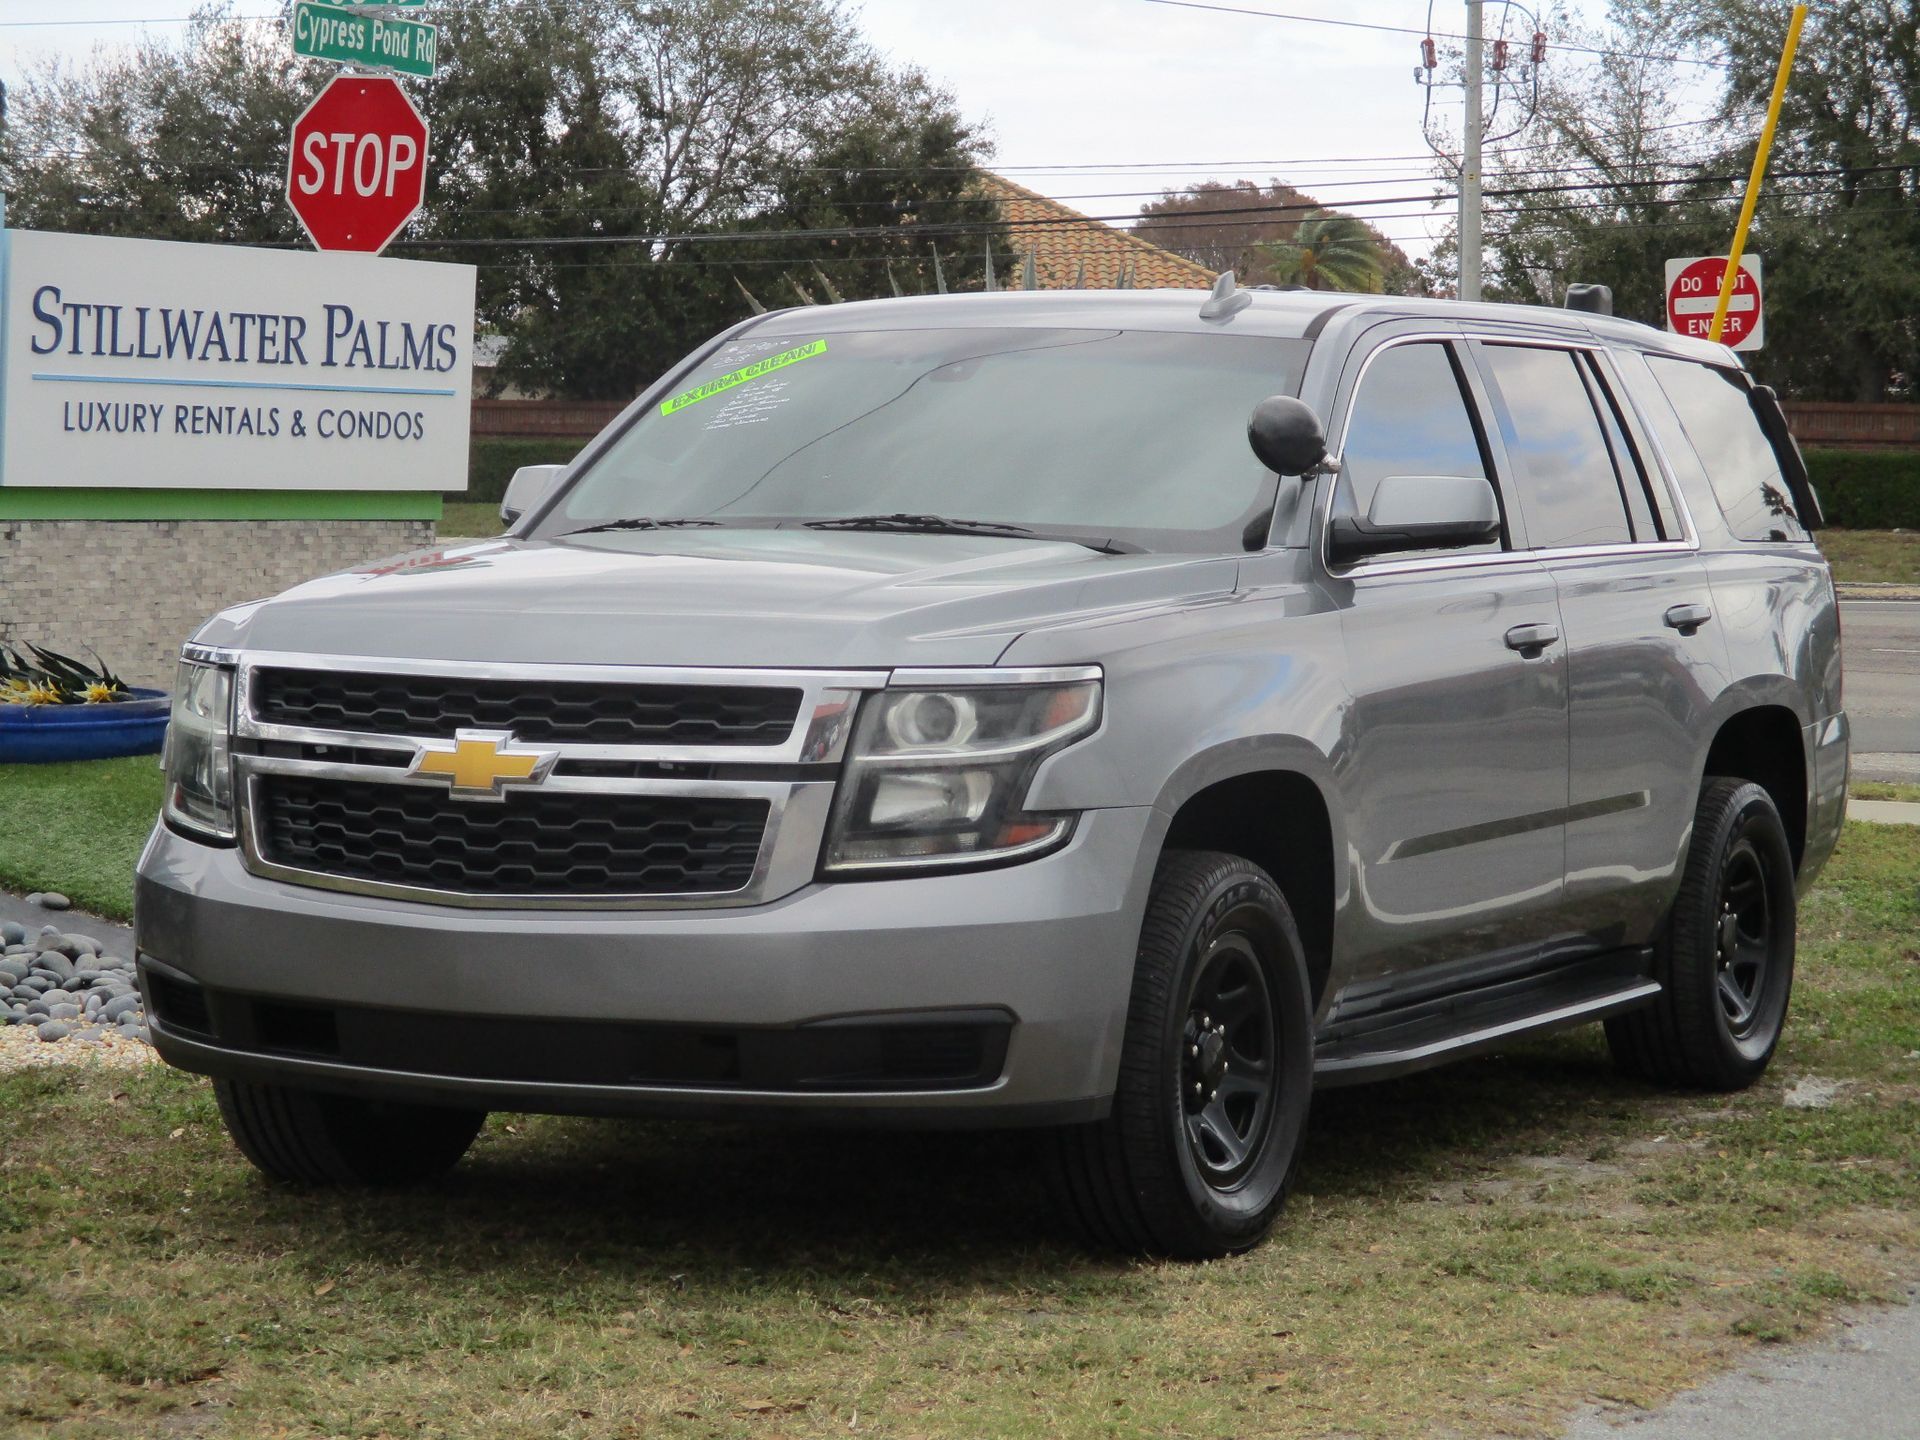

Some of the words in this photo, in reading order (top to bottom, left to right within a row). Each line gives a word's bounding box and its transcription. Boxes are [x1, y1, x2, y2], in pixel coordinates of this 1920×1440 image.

[297, 6, 364, 52] Cypress
[372, 19, 410, 58] Pond
[416, 28, 434, 63] Rd
[299, 131, 416, 197] STOP
[1681, 277, 1702, 292] DO
[31, 285, 307, 365] STILLWATER
[321, 304, 457, 372] PALMS
[1688, 317, 1741, 334] ENER
[671, 372, 743, 410] EXTRA
[746, 343, 818, 377] CLEAN
[64, 401, 163, 433] LUXURY
[175, 405, 280, 437] RENTALS
[292, 412, 306, 437] &
[317, 409, 424, 440] CONDOS
